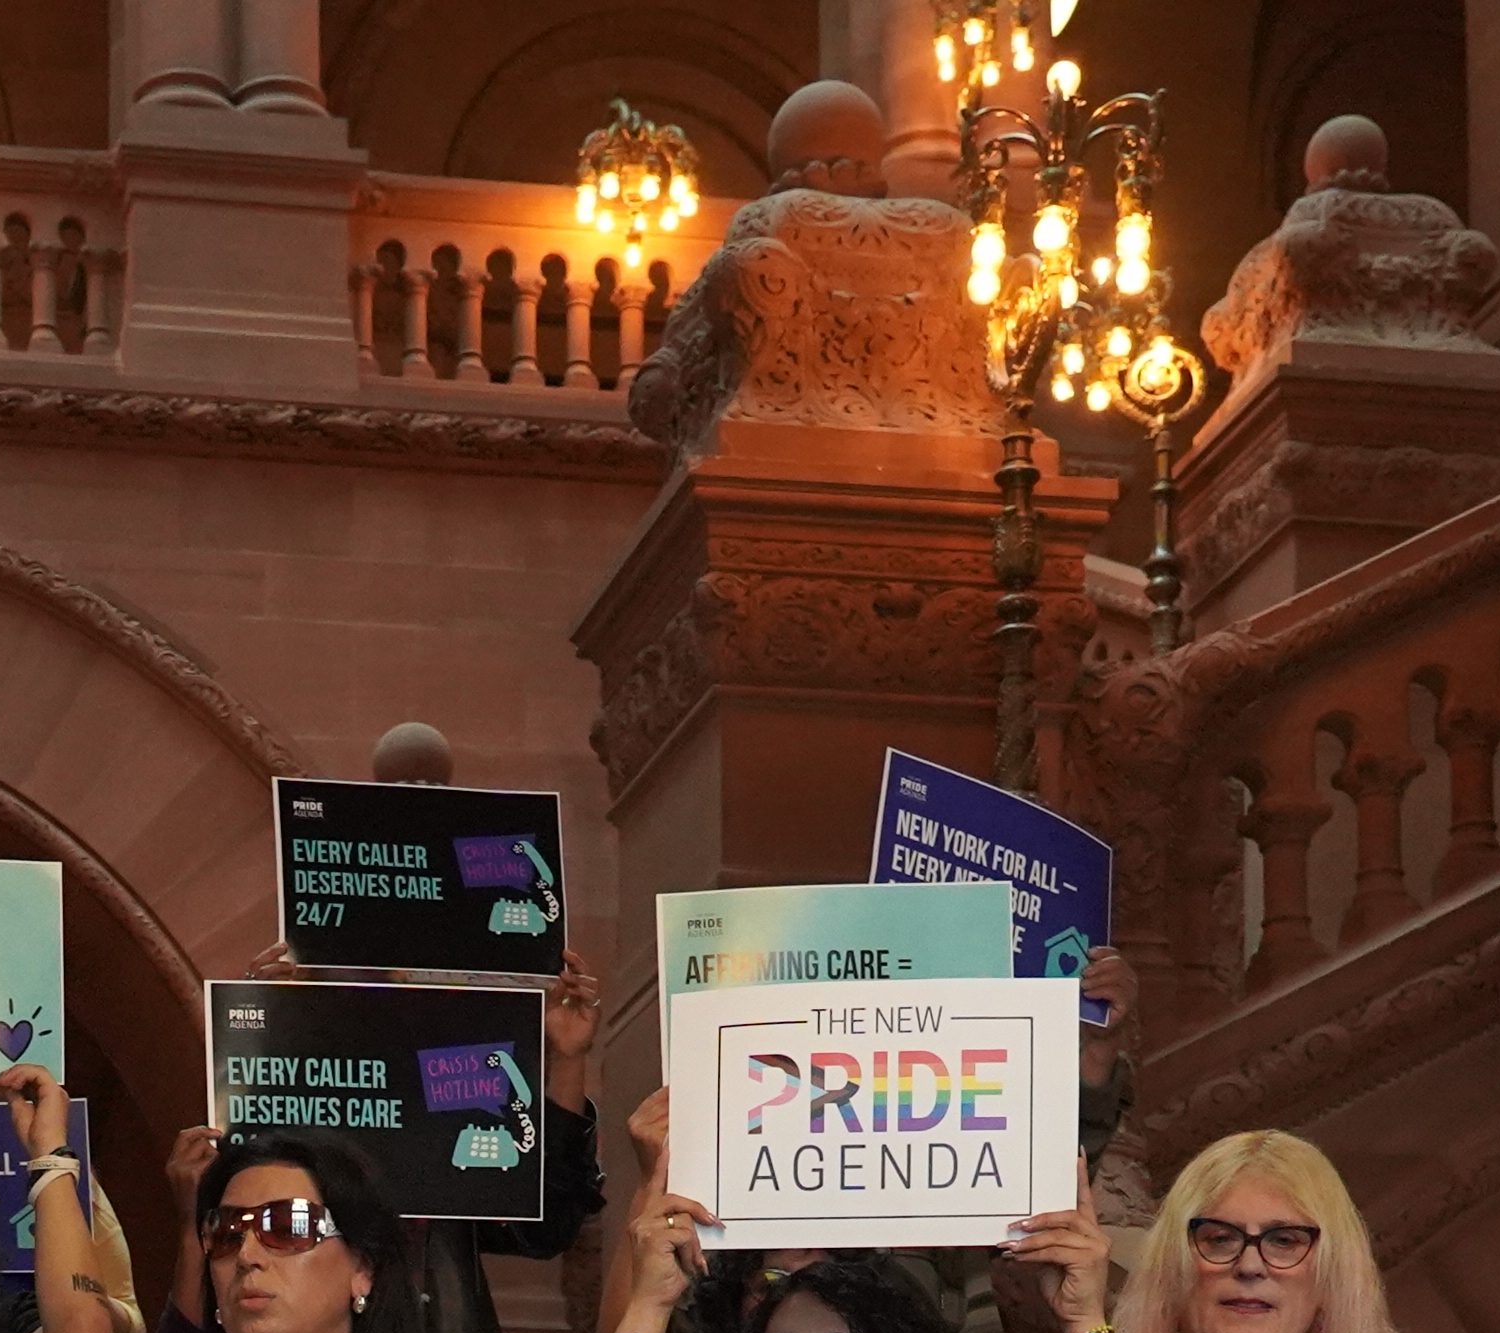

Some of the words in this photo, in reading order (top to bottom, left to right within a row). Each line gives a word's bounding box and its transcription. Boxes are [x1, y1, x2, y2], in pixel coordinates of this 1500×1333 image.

[900, 777, 928, 795] PRIDE
[293, 801, 323, 812] PRIDE
[293, 839, 353, 864] EVERY
[358, 842, 428, 868] CALLER
[896, 809, 939, 847] NEW
[943, 825, 990, 868] YORK
[992, 845, 1027, 880] FOR
[1029, 860, 1060, 894] ALL
[294, 870, 390, 898] DESERVES
[394, 876, 444, 900] CARE
[296, 902, 344, 927] 24/7
[687, 917, 723, 929] PRIDE
[685, 950, 819, 985] AFFIRMING
[827, 950, 890, 980] CARE
[229, 1009, 265, 1020] PRIDE
[811, 1008, 866, 1035] THE
[875, 1006, 943, 1033] NEW
[227, 1056, 299, 1087] EVERY
[305, 1058, 387, 1089] CALLER
[747, 1049, 1008, 1135] PRIDE
[229, 1095, 341, 1126] DESERVES
[346, 1100, 402, 1129] CARE
[748, 1141, 1003, 1192] AGENDA
